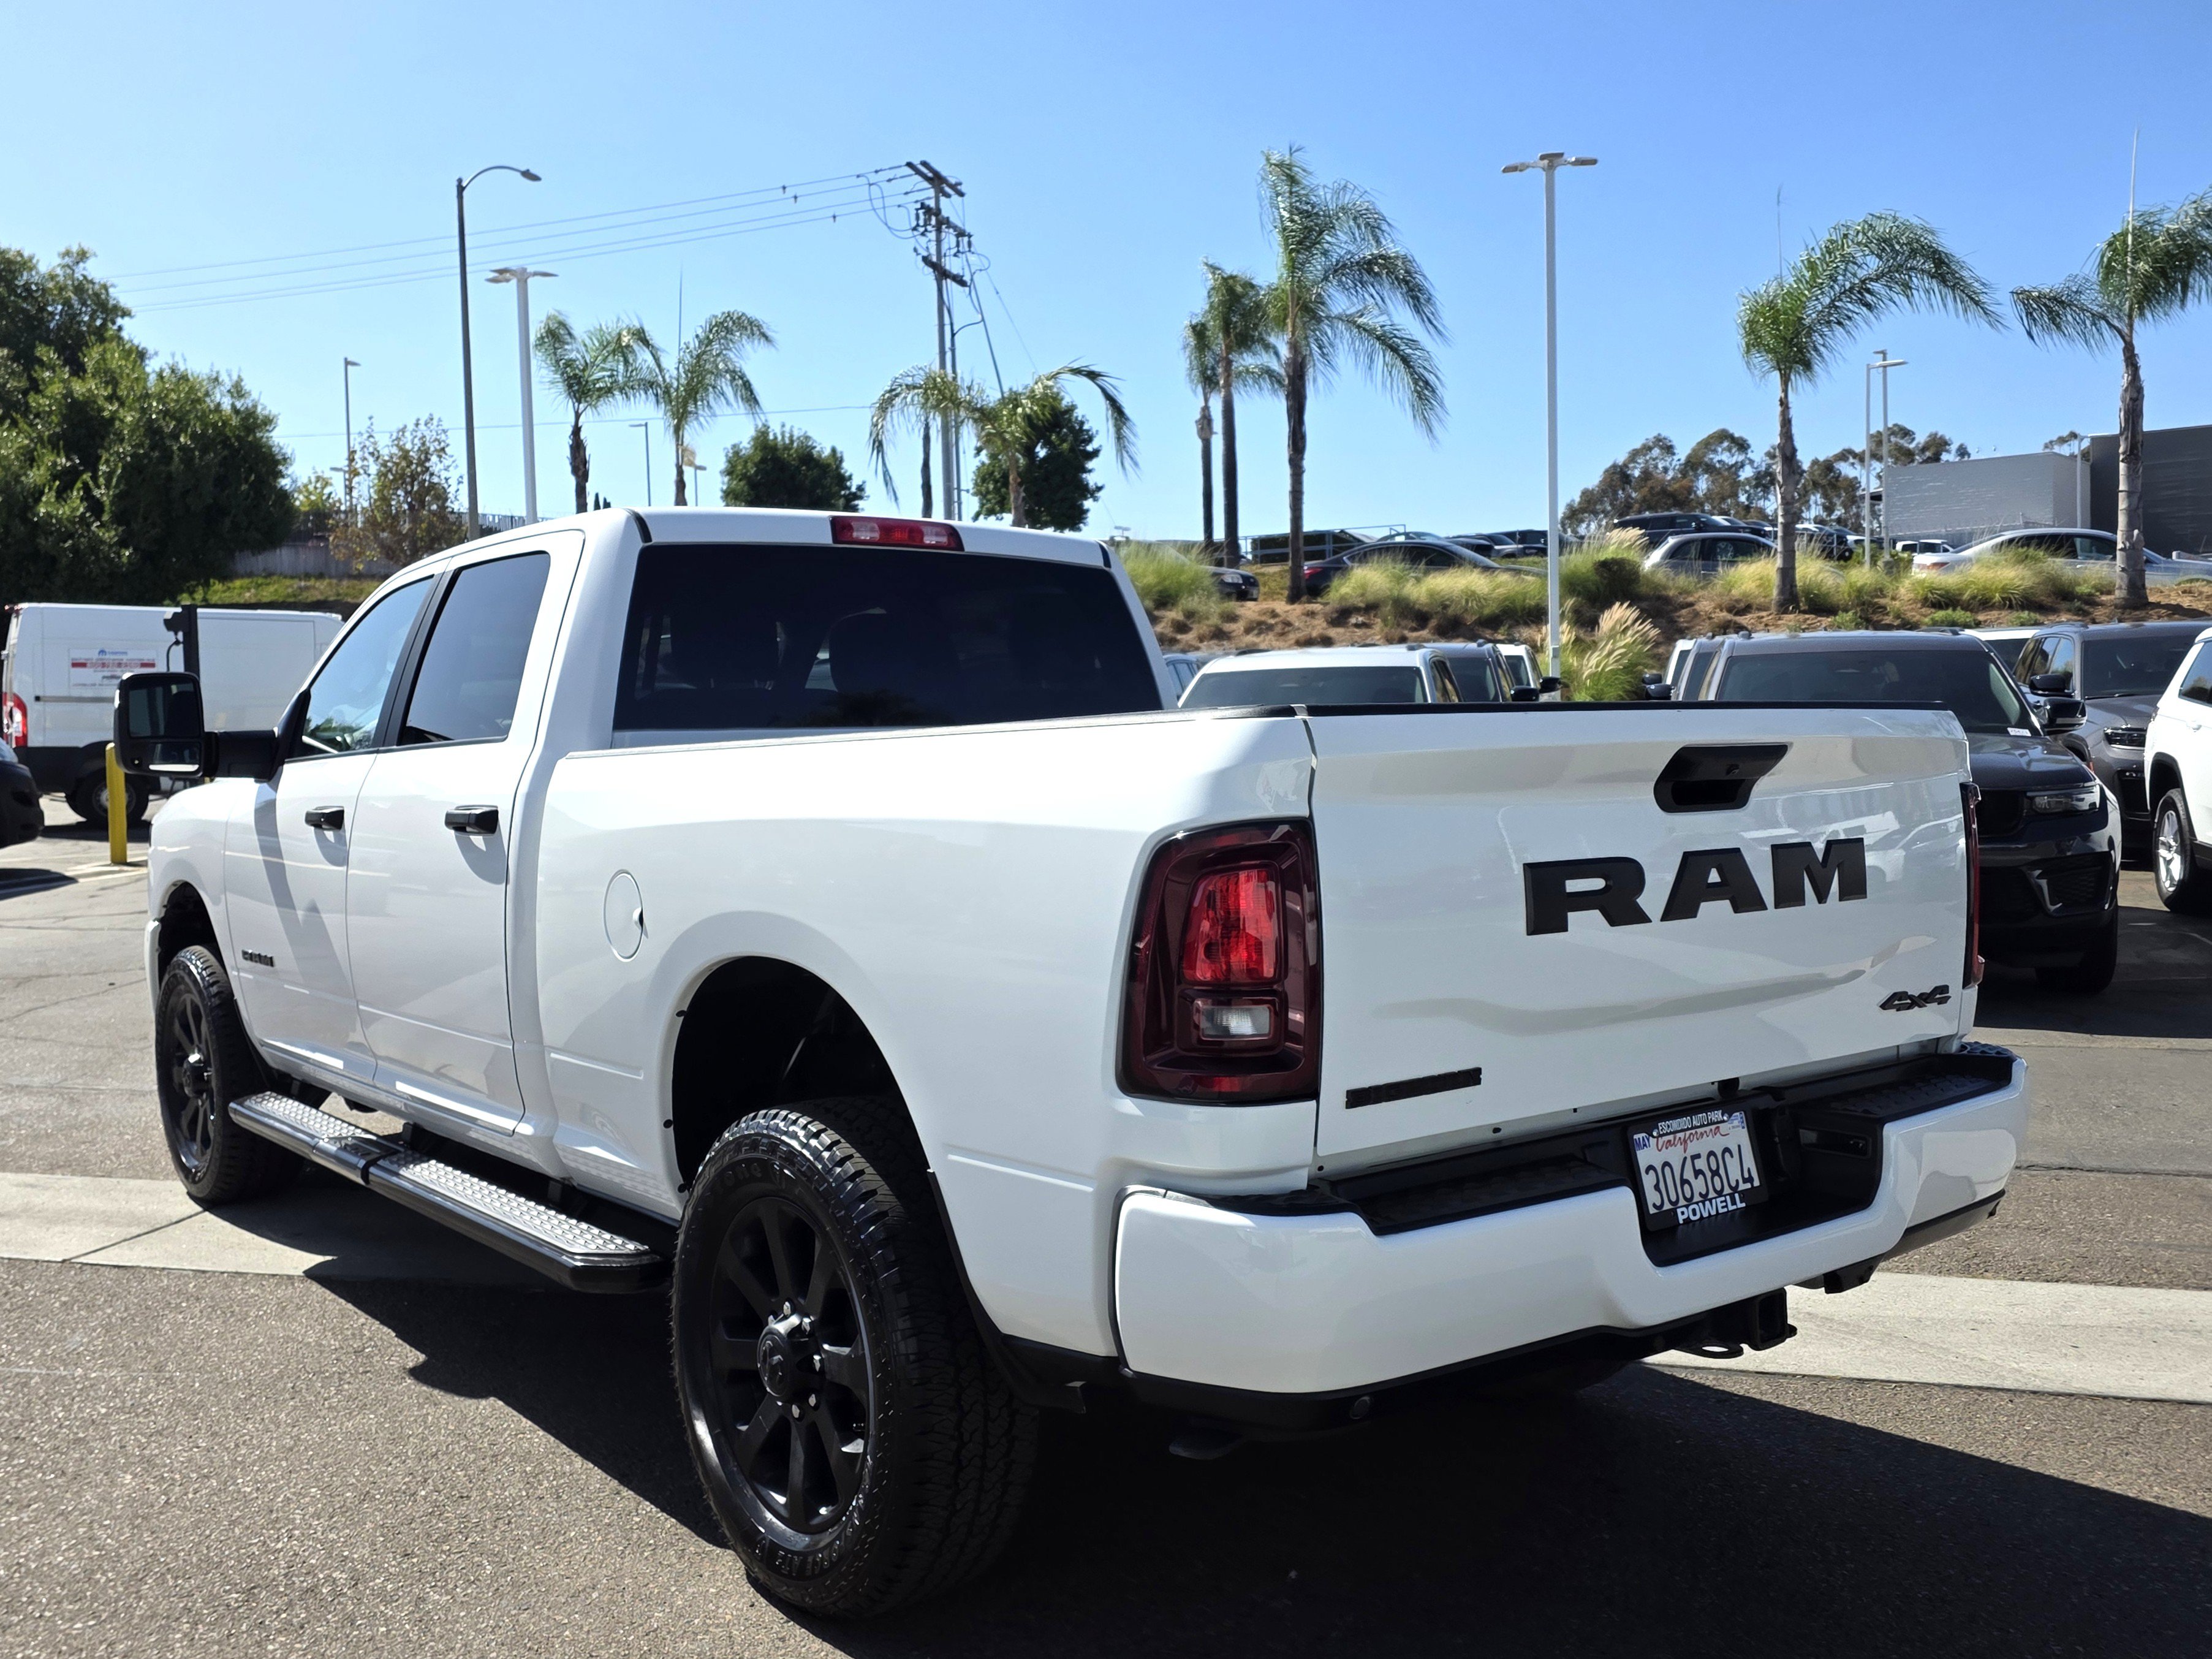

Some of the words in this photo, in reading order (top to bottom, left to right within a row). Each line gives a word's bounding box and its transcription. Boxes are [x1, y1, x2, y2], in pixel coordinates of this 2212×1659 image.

[1523, 837, 1868, 936] RAM
[1657, 1117, 1692, 1134] ESCONDIDO
[1692, 1113, 1708, 1126] AUTO
[1708, 1110, 1724, 1123] PARK
[1634, 1135, 1651, 1152] MAY
[1656, 1125, 1730, 1153] California
[1645, 1144, 1754, 1211] 30658C4
[1676, 1193, 1746, 1224] POWELL
